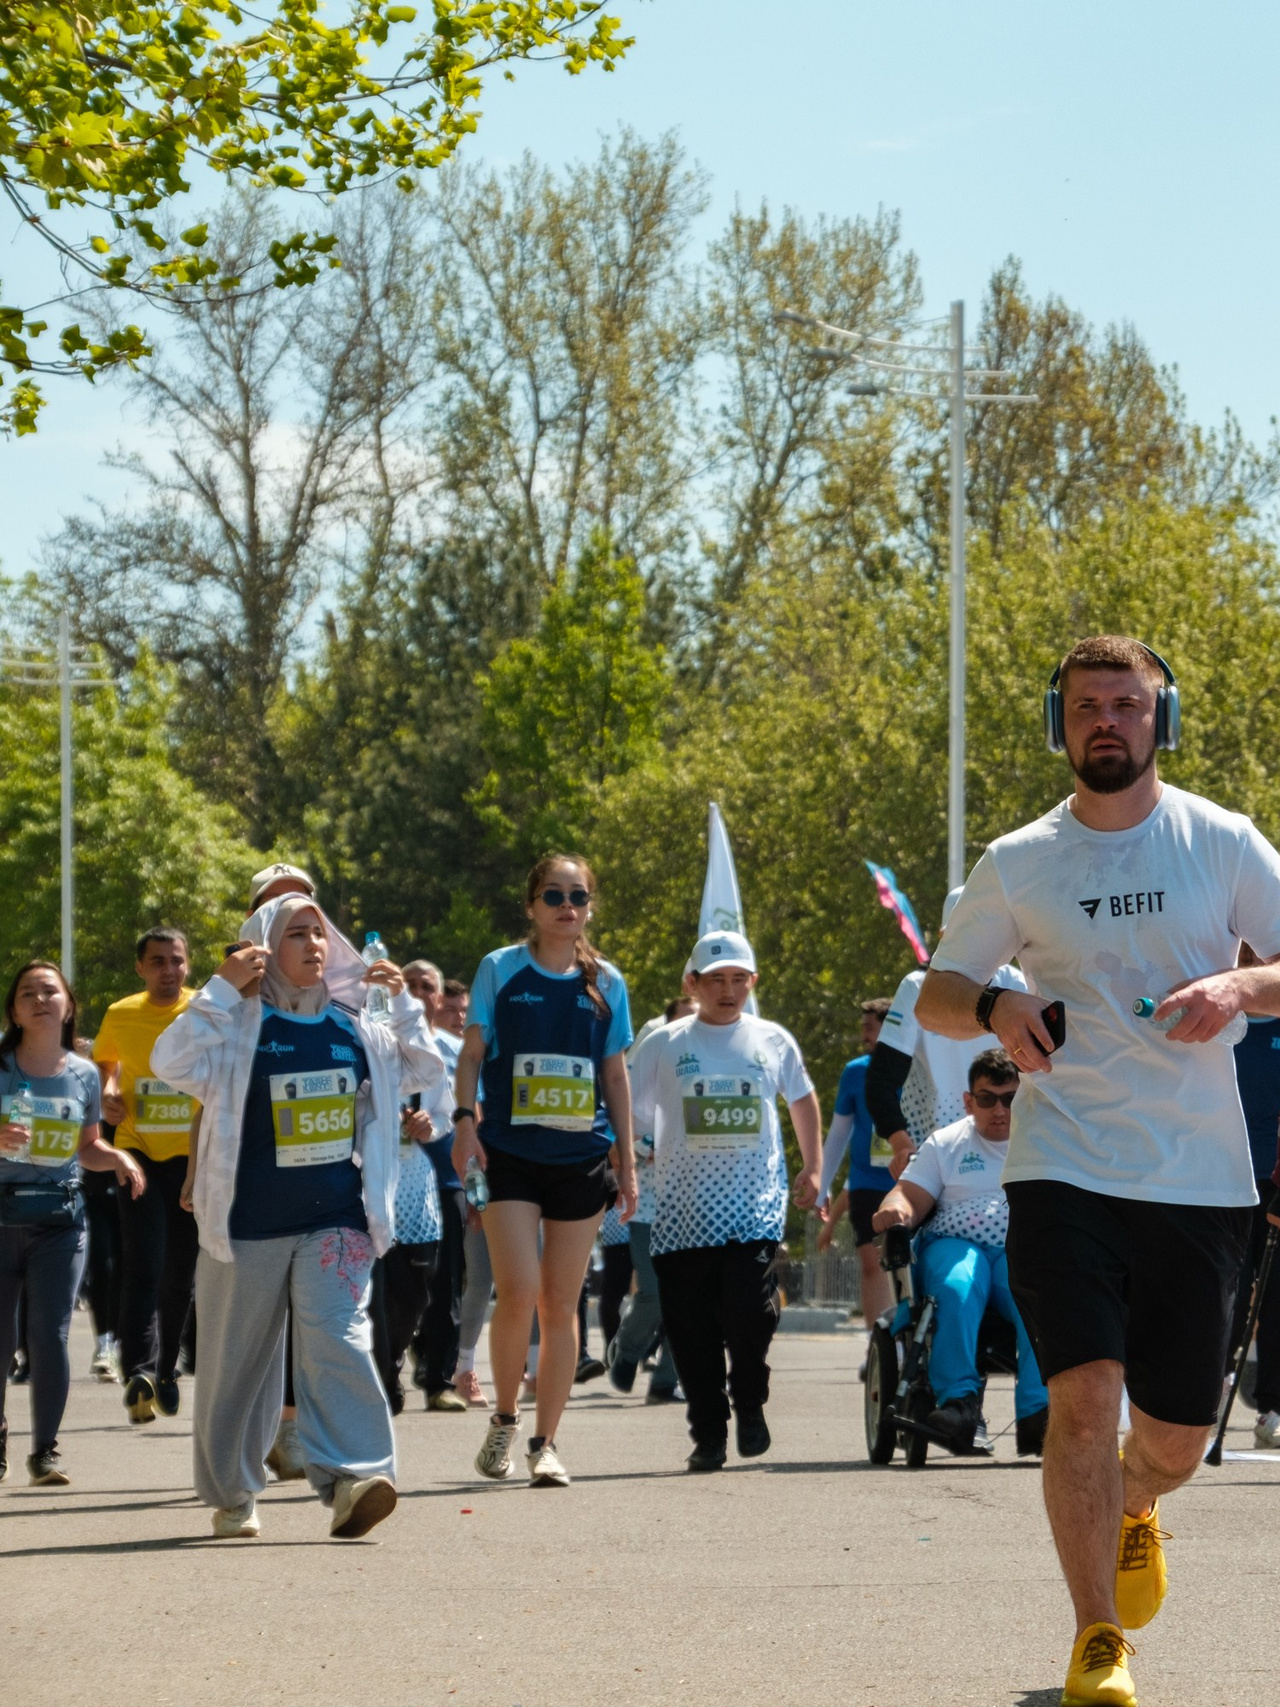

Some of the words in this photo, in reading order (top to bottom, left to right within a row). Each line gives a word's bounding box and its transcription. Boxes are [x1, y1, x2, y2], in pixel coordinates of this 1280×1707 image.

[1109, 891, 1165, 917] BEFIT
[533, 1088, 590, 1108] 4517
[147, 1104, 190, 1119] 7386
[299, 1107, 351, 1135] 5656
[703, 1107, 758, 1127] 9499
[35, 1130, 74, 1151] 175
